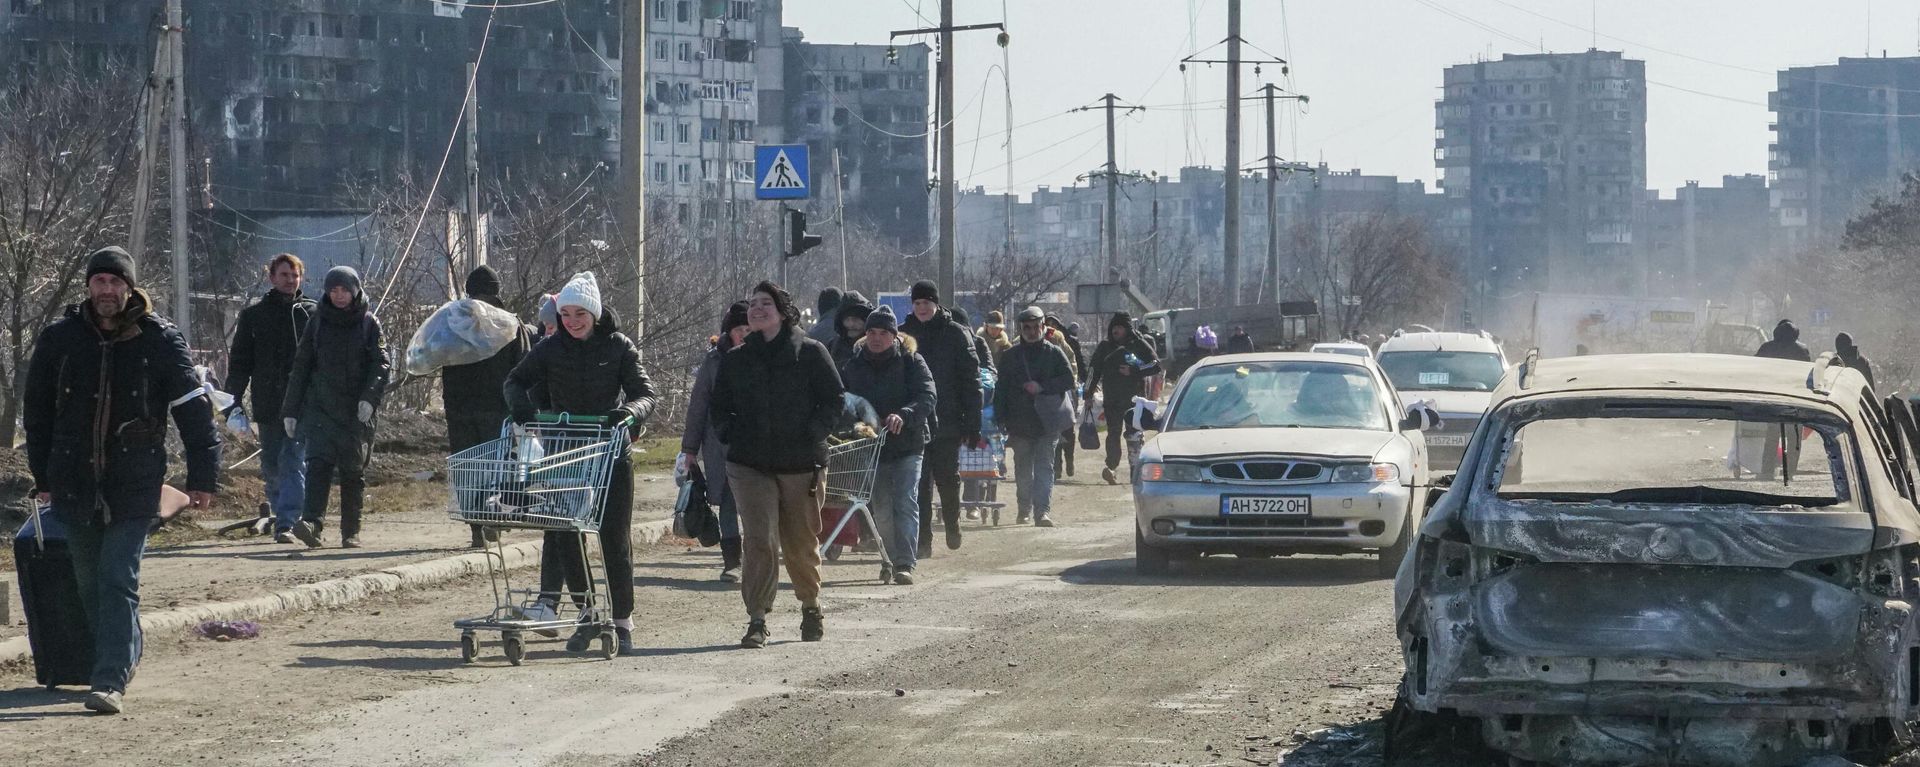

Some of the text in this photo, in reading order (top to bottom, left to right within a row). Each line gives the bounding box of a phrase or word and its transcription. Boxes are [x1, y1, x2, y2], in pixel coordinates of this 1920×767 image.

[1230, 499, 1307, 513] AH 3722 OH
